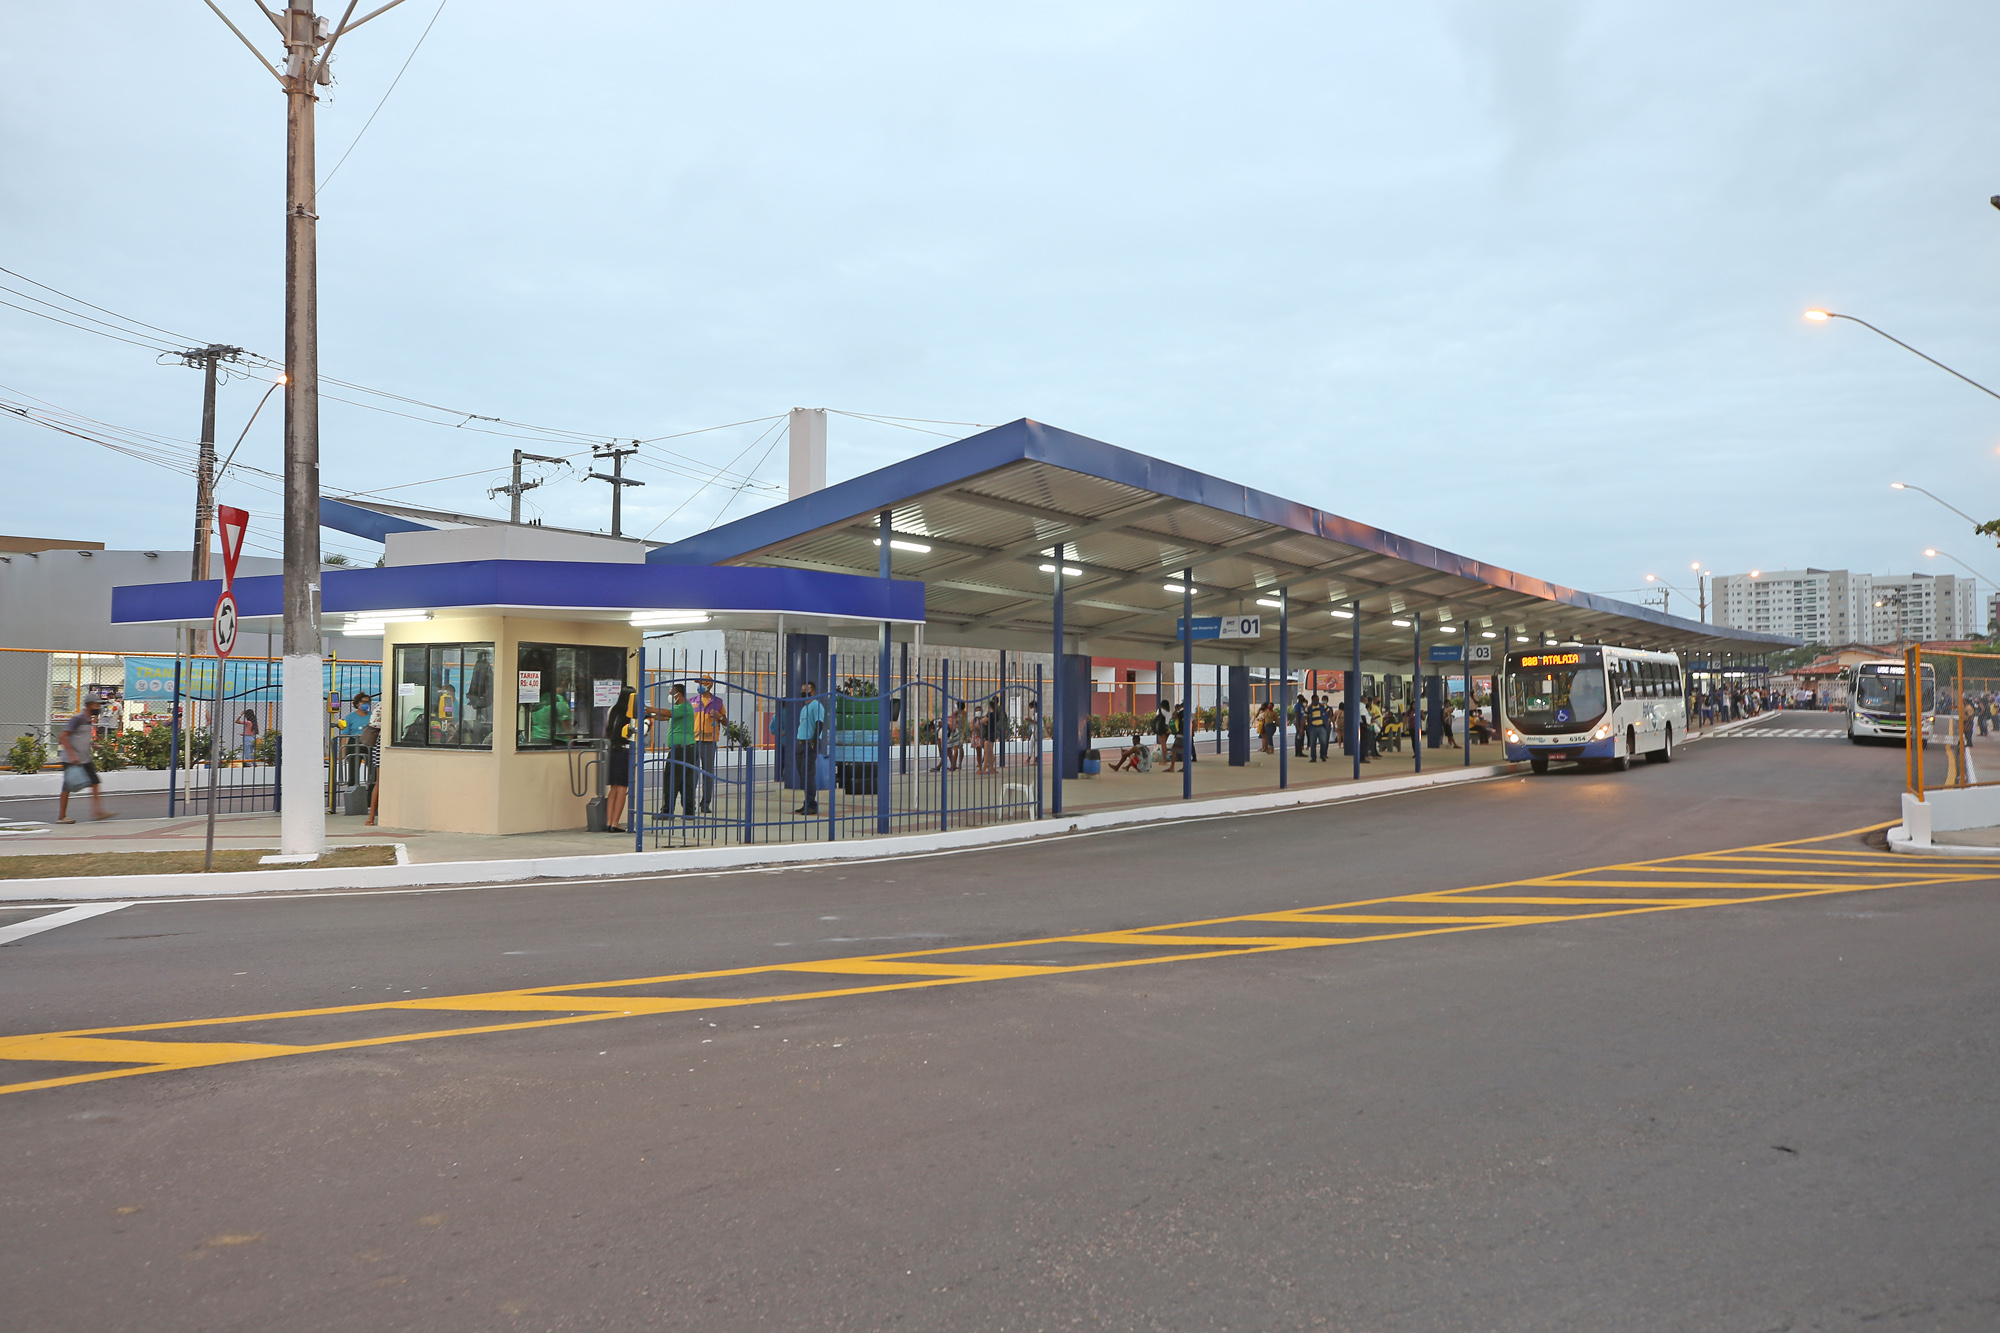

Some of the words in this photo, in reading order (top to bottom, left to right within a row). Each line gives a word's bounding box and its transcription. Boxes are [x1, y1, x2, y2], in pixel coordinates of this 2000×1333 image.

[1241, 619, 1259, 634] 01
[1476, 647, 1490, 658] 03
[1542, 653, 1579, 665] ATALAIA
[136, 667, 218, 679] TRANPORT
[179, 679, 234, 691] CUIDAO
[529, 680, 539, 688] 4,00
